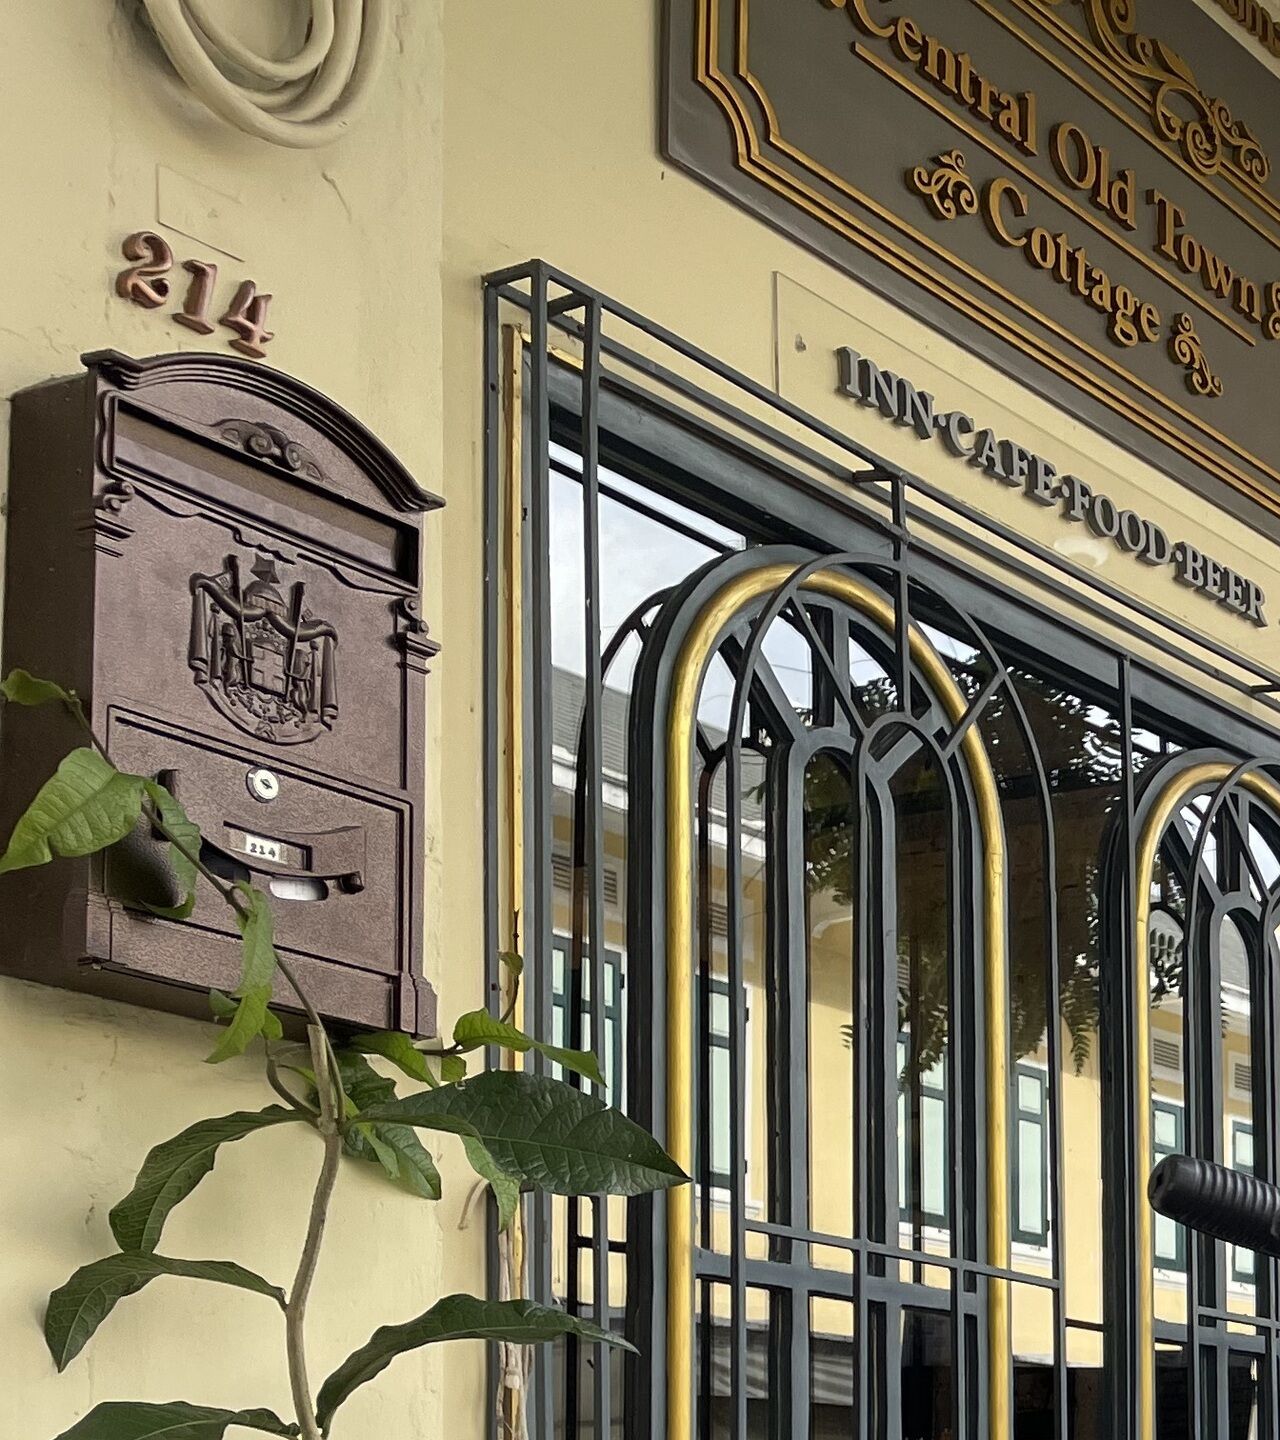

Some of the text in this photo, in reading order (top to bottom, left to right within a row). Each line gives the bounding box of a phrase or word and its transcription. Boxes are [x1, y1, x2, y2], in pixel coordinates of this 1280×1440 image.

[838, 0, 1261, 324] Central Old Town
[117, 231, 275, 358] 214
[983, 176, 1161, 346] Cottage
[249, 842, 276, 858] 214
